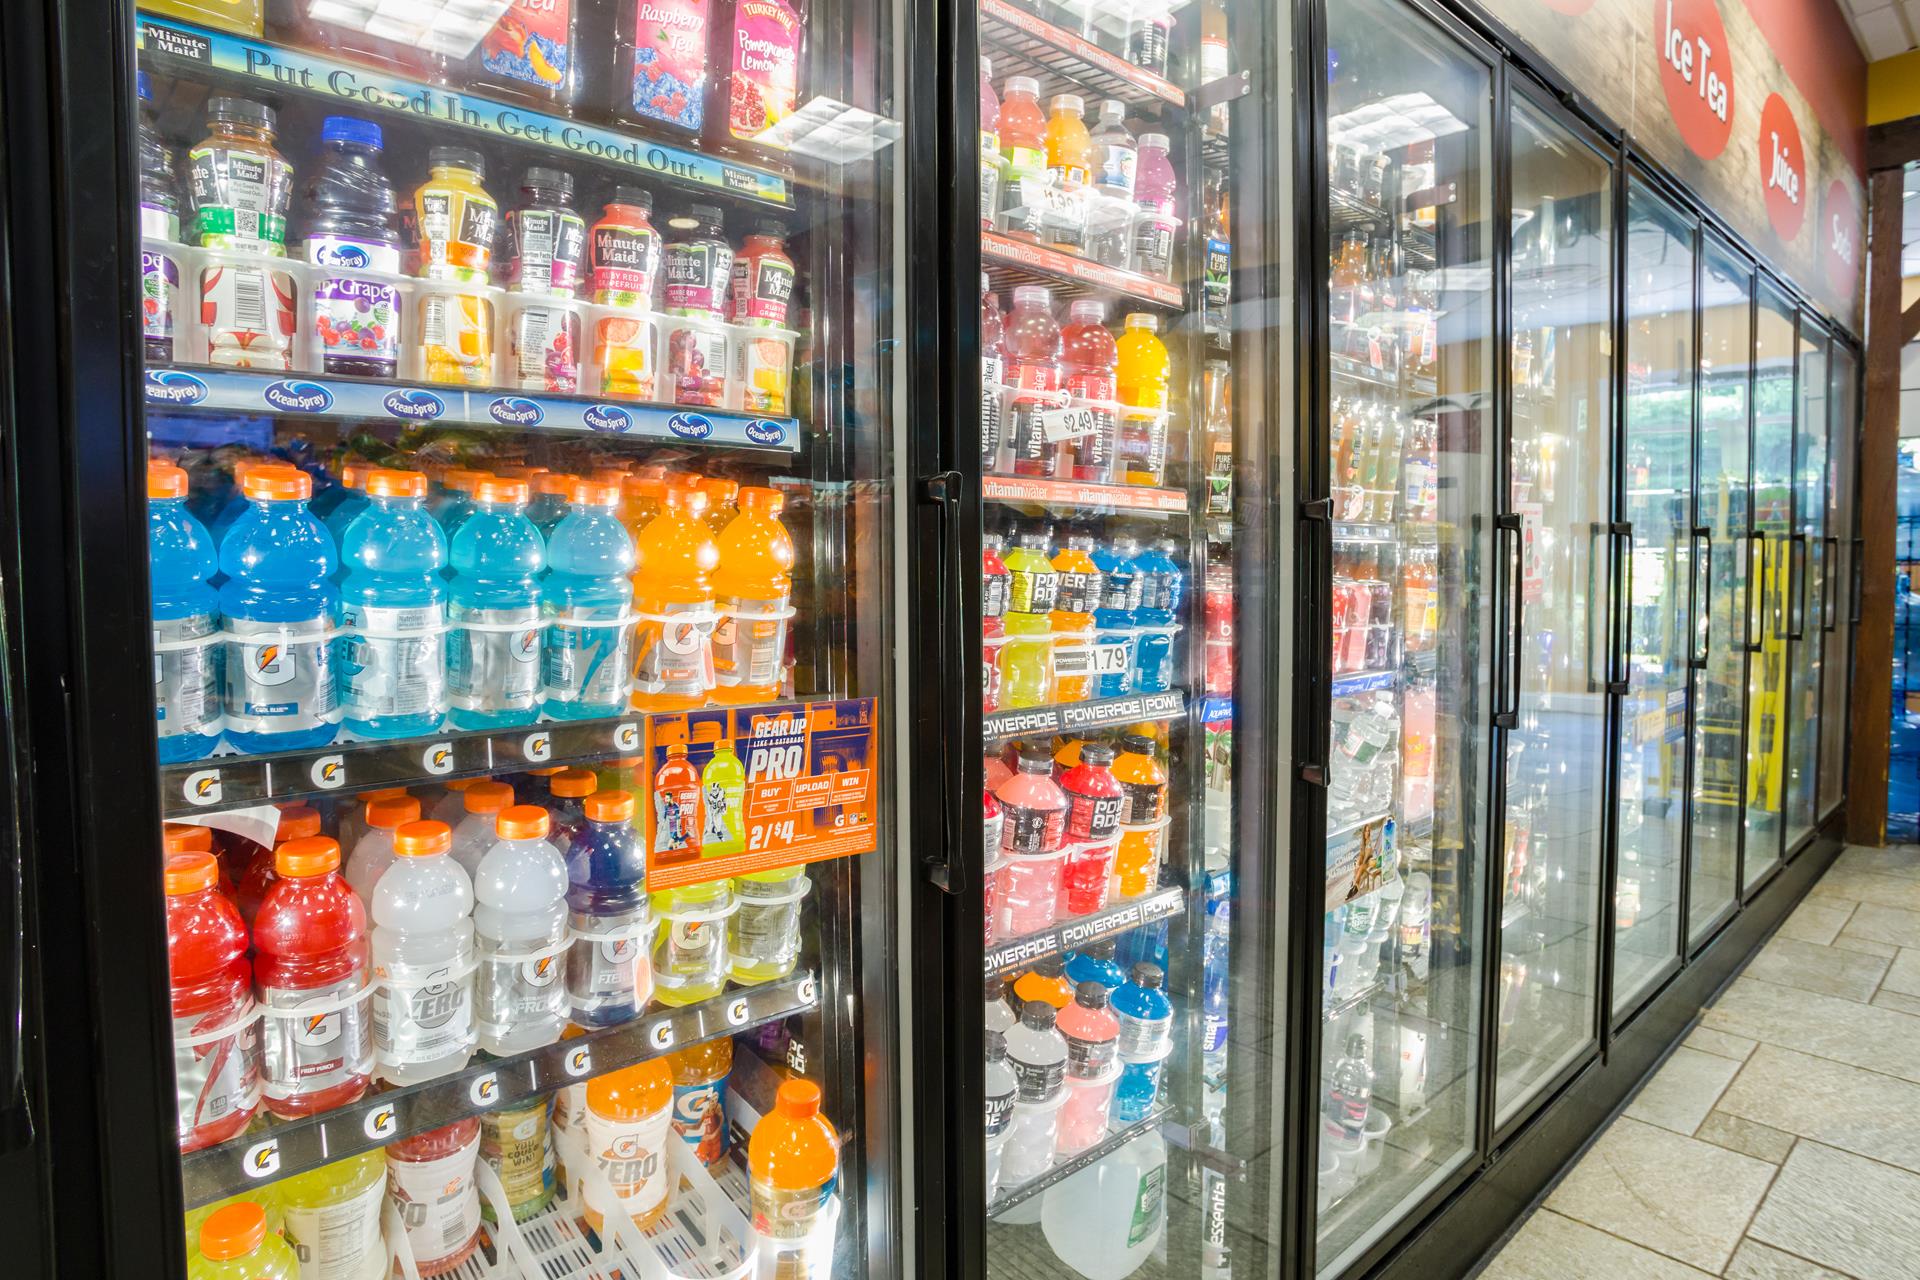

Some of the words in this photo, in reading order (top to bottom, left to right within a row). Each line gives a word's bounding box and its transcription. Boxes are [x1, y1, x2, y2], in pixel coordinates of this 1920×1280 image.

[640, 3, 704, 32] Raspberry
[744, 3, 777, 19] TURKEY
[148, 26, 207, 50] Minute
[670, 33, 696, 54] Tea
[1664, 0, 1693, 83] Ice
[1698, 37, 1727, 122] Tea
[241, 46, 314, 89] Put
[327, 69, 432, 117] Good
[446, 94, 490, 129] In.
[496, 111, 553, 145] Get
[560, 127, 640, 167] Good
[646, 148, 705, 181] Out.
[232, 161, 262, 173] Minute
[724, 169, 758, 185] Minute
[1769, 131, 1799, 204] Juice
[597, 231, 645, 252] Minute
[1211, 252, 1228, 264] PURE
[622, 272, 639, 281] RED
[339, 280, 393, 303] Grape
[145, 385, 167, 400] ean
[167, 385, 198, 405] Spray
[268, 390, 297, 408] Ocean
[298, 392, 325, 410] Spray
[387, 397, 413, 414] Ocean
[413, 399, 437, 417] Spray
[492, 405, 516, 421] Ocean
[515, 407, 538, 424] Spray
[586, 413, 607, 428] Ocean
[606, 415, 627, 431] Spray
[670, 420, 689, 434] Ocean
[689, 422, 708, 437] Spray
[1063, 411, 1093, 433] $2.49
[747, 426, 765, 439] Ocean
[765, 428, 783, 443] Spray
[1215, 454, 1231, 463] PURE
[983, 483, 1048, 500] vitaminwater
[1078, 488, 1132, 506] vitaminwater
[1064, 699, 1141, 723] POWERADE
[755, 720, 790, 739] GEAR
[790, 718, 807, 735] UP
[983, 711, 1058, 735] OWERADE
[523, 732, 551, 762] G
[613, 723, 639, 751] G
[753, 739, 768, 748] LIKE
[423, 743, 453, 775] G
[748, 745, 803, 783] PRO
[311, 755, 345, 789] G
[842, 777, 859, 786] WIN
[183, 769, 222, 805] G
[795, 781, 829, 793] UPLOAD
[834, 814, 844, 827] G
[1063, 908, 1140, 944] POWERADE
[985, 934, 1058, 972] OWERADE
[406, 986, 466, 1020] ZERO
[727, 998, 749, 1026] G
[650, 1020, 674, 1049] G
[1203, 1014, 1220, 1052] smart
[301, 1065, 316, 1075] FRUIT
[316, 1063, 335, 1072] PUNCH
[565, 1045, 592, 1077] G
[469, 1072, 499, 1106] G
[364, 1103, 396, 1139] G
[243, 1138, 280, 1178] G
[598, 1152, 658, 1183] ZERO
